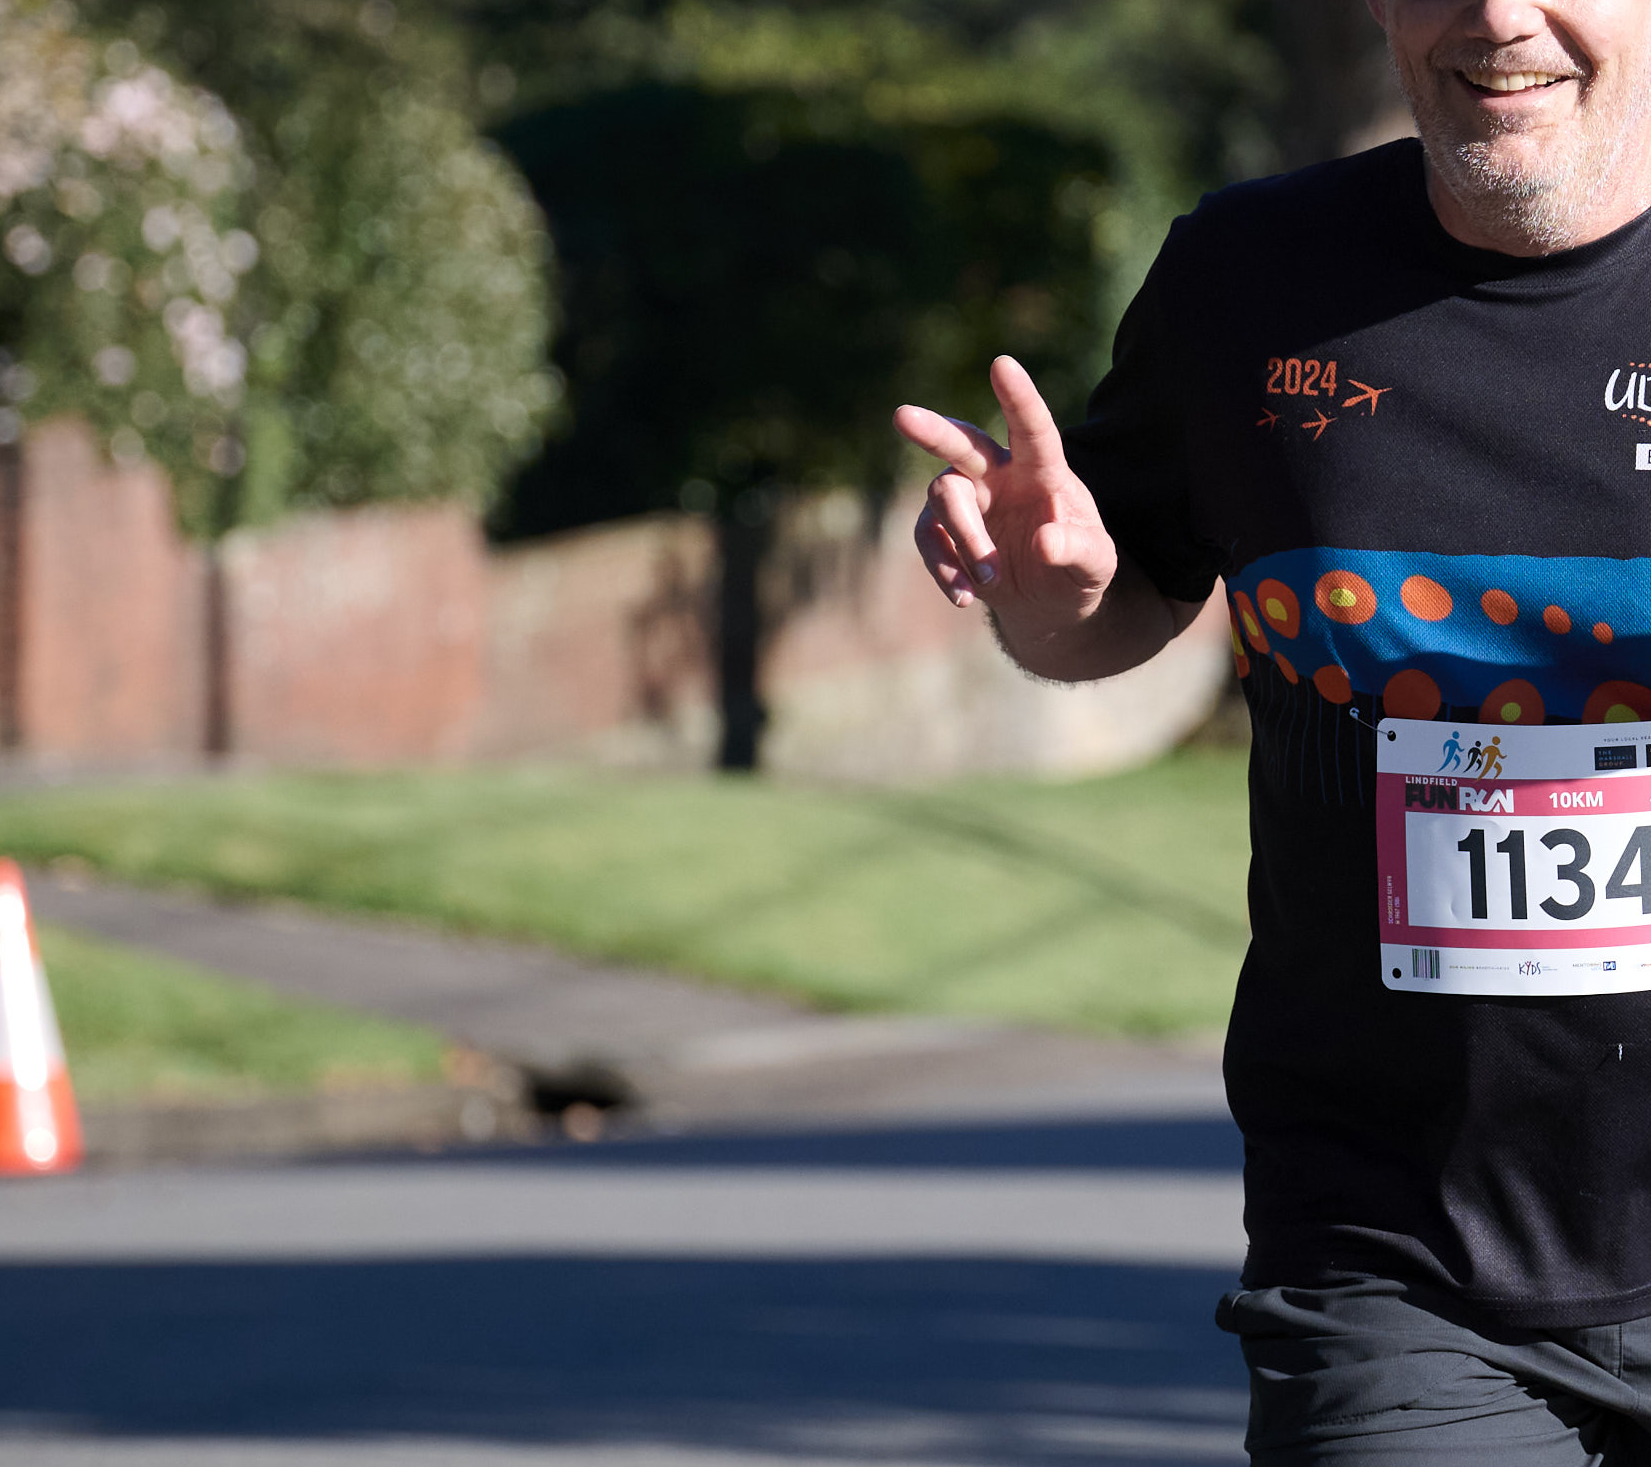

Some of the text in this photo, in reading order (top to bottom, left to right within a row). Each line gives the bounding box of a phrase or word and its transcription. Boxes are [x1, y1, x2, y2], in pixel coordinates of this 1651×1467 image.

[1266, 357, 1337, 397] 2024
[1405, 776, 1458, 787] LINDFIELD
[1549, 791, 1604, 808] 10KM
[1518, 961, 1541, 975] KYDS
